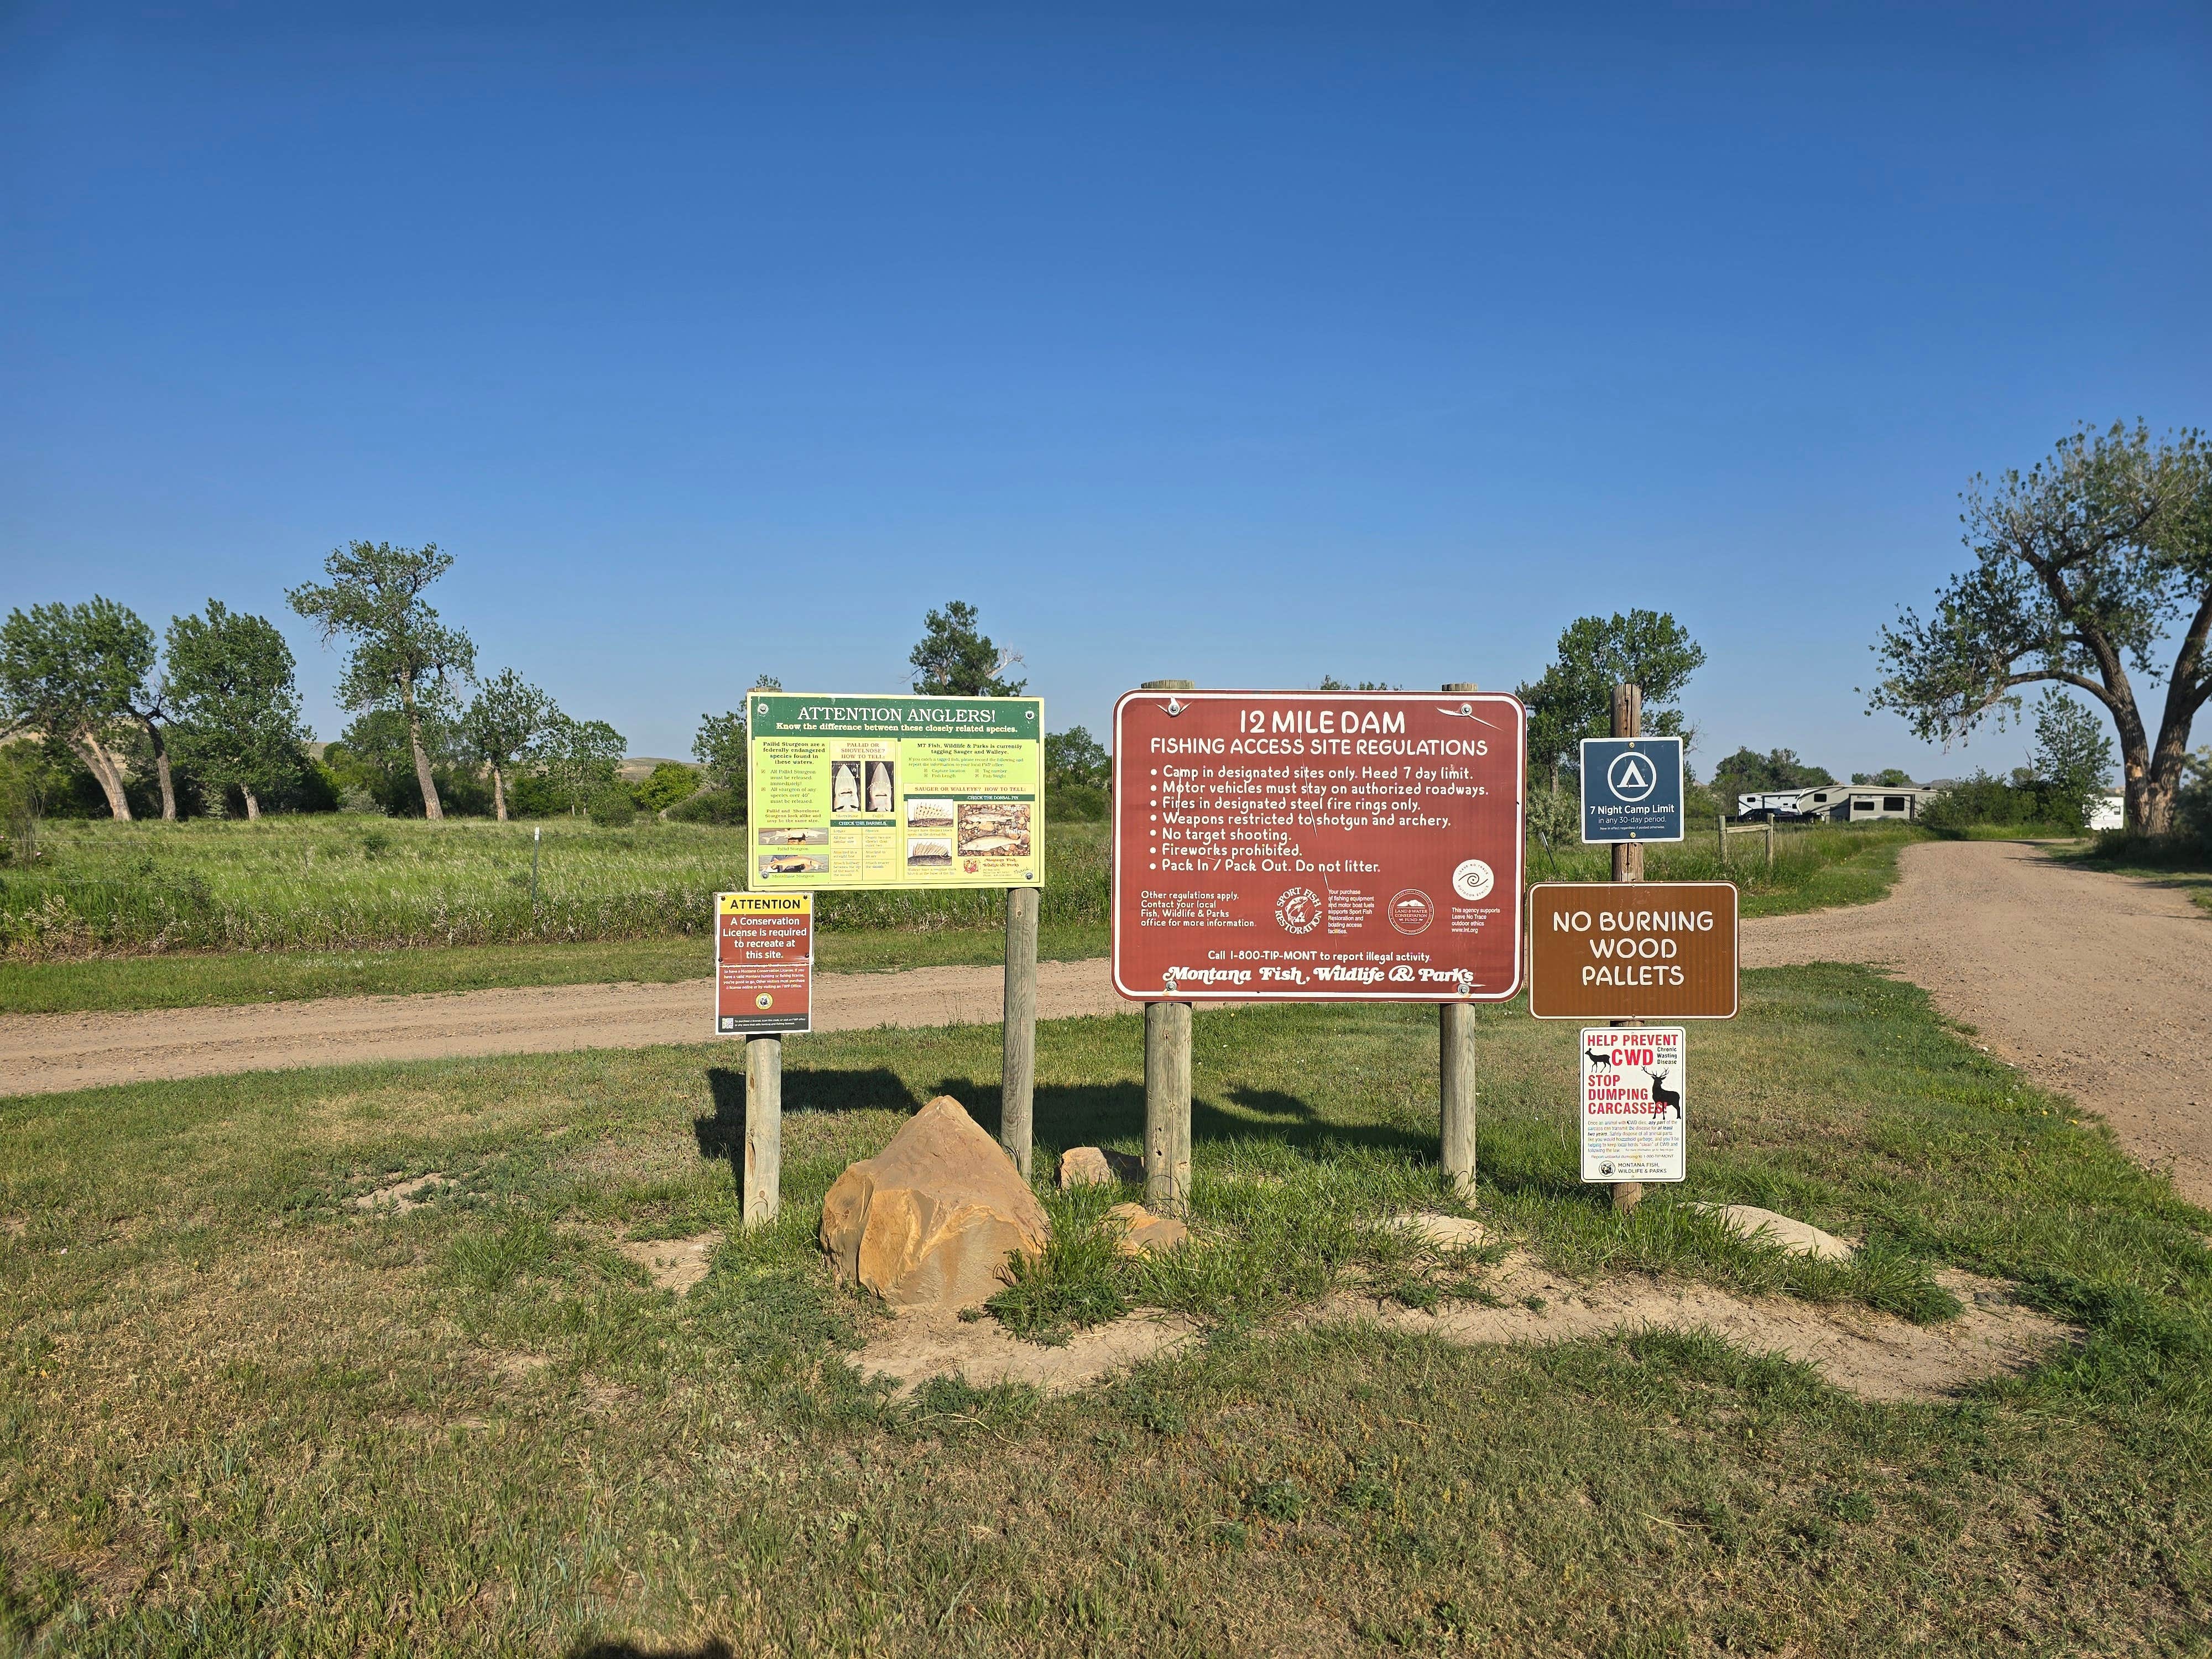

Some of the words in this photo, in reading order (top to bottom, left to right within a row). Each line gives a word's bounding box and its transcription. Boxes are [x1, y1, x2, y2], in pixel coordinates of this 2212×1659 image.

[797, 707, 902, 722] ATTENTION
[907, 708, 995, 722] ANGLERS!
[1240, 710, 1265, 733] 12
[1272, 710, 1334, 734] MILE
[1341, 711, 1405, 734] DAM
[926, 724, 953, 733] closely
[987, 726, 1018, 734] species.
[1150, 738, 1225, 754] FISHING
[1230, 738, 1305, 755] ACCESS
[1310, 739, 1351, 755] SITE
[1357, 739, 1488, 756] REGULATIONS
[1163, 765, 1199, 781] Camp
[1203, 765, 1214, 778] in
[1218, 765, 1290, 784] designated
[1294, 766, 1324, 779] sites
[1328, 766, 1358, 781] only.
[1362, 766, 1398, 779] Heed
[1403, 766, 1411, 779] 7
[1415, 766, 1437, 781] day
[1441, 767, 1473, 780] limit.
[1163, 781, 1206, 794] Motor
[1209, 781, 1262, 794] vehicles
[1266, 782, 1297, 794] must
[1301, 782, 1327, 796] stay
[1331, 785, 1347, 794] on
[1351, 781, 1421, 795] authorized
[1425, 782, 1489, 797] roadways.
[1162, 796, 1195, 809] Fires
[1199, 797, 1210, 809] in
[1214, 797, 1286, 815] designated
[1290, 797, 1323, 810] steel
[1327, 797, 1352, 810] fire
[1355, 797, 1387, 815] rings
[1391, 798, 1421, 812] only.
[1598, 806, 1622, 816] Night
[1625, 805, 1650, 815] Camp
[1652, 804, 1674, 813] Limit
[1162, 812, 1224, 828] Weapons
[1228, 812, 1293, 825] restricted
[1298, 813, 1312, 825] to
[1316, 813, 1368, 830] shotgun
[1372, 813, 1395, 826] and
[1399, 813, 1451, 828] archery.
[1162, 828, 1181, 840] No
[1186, 828, 1226, 845] target
[1230, 828, 1292, 846] shooting.
[1162, 843, 1227, 855] Fireworks
[1232, 844, 1302, 859] prohibited.
[1162, 859, 1193, 871] Pack
[1197, 859, 1209, 871] In
[1213, 859, 1221, 872] /
[1225, 859, 1256, 872] Pack
[1261, 859, 1292, 872] Out.
[1296, 860, 1314, 872] Do
[1318, 860, 1340, 872] not
[1345, 860, 1381, 873] litter.
[1141, 890, 1166, 899] Other
[1169, 891, 1214, 902] regulations
[1217, 891, 1239, 901] apply.
[1276, 887, 1302, 908] SPORT
[1303, 888, 1322, 907] FISH
[730, 899, 800, 909] ATTENTION
[1176, 902, 1194, 910] your
[731, 917, 738, 925] A
[740, 917, 800, 925] Conservation
[1141, 909, 1159, 918] Fish,
[1275, 910, 1323, 935] RESTORATION
[1553, 911, 1592, 932] NO
[1600, 911, 1713, 931] BURNING
[723, 928, 757, 937] License
[769, 928, 807, 937] required
[746, 951, 763, 959] this
[1589, 938, 1677, 958] WOOD
[1208, 951, 1225, 961] Call
[1230, 950, 1318, 961] 1-800-TIP-MONT
[1320, 952, 1331, 961] to
[1333, 951, 1364, 963] report
[1366, 951, 1394, 964] illegal
[1396, 952, 1432, 964] activity.
[1162, 966, 1252, 984] Montana
[1259, 967, 1310, 985] Fish,
[1313, 966, 1385, 984] Wildlife
[1388, 965, 1415, 982] &
[1418, 967, 1474, 984] Parks
[1582, 966, 1684, 985] PALLETS
[1588, 1035, 1618, 1046] HELP
[1623, 1035, 1678, 1046] PREVENT
[1612, 1048, 1653, 1066] CWD
[1588, 1075, 1620, 1087] STOP
[1588, 1088, 1648, 1100] DUMPING
[1588, 1102, 1667, 1114] CARCASSES!
